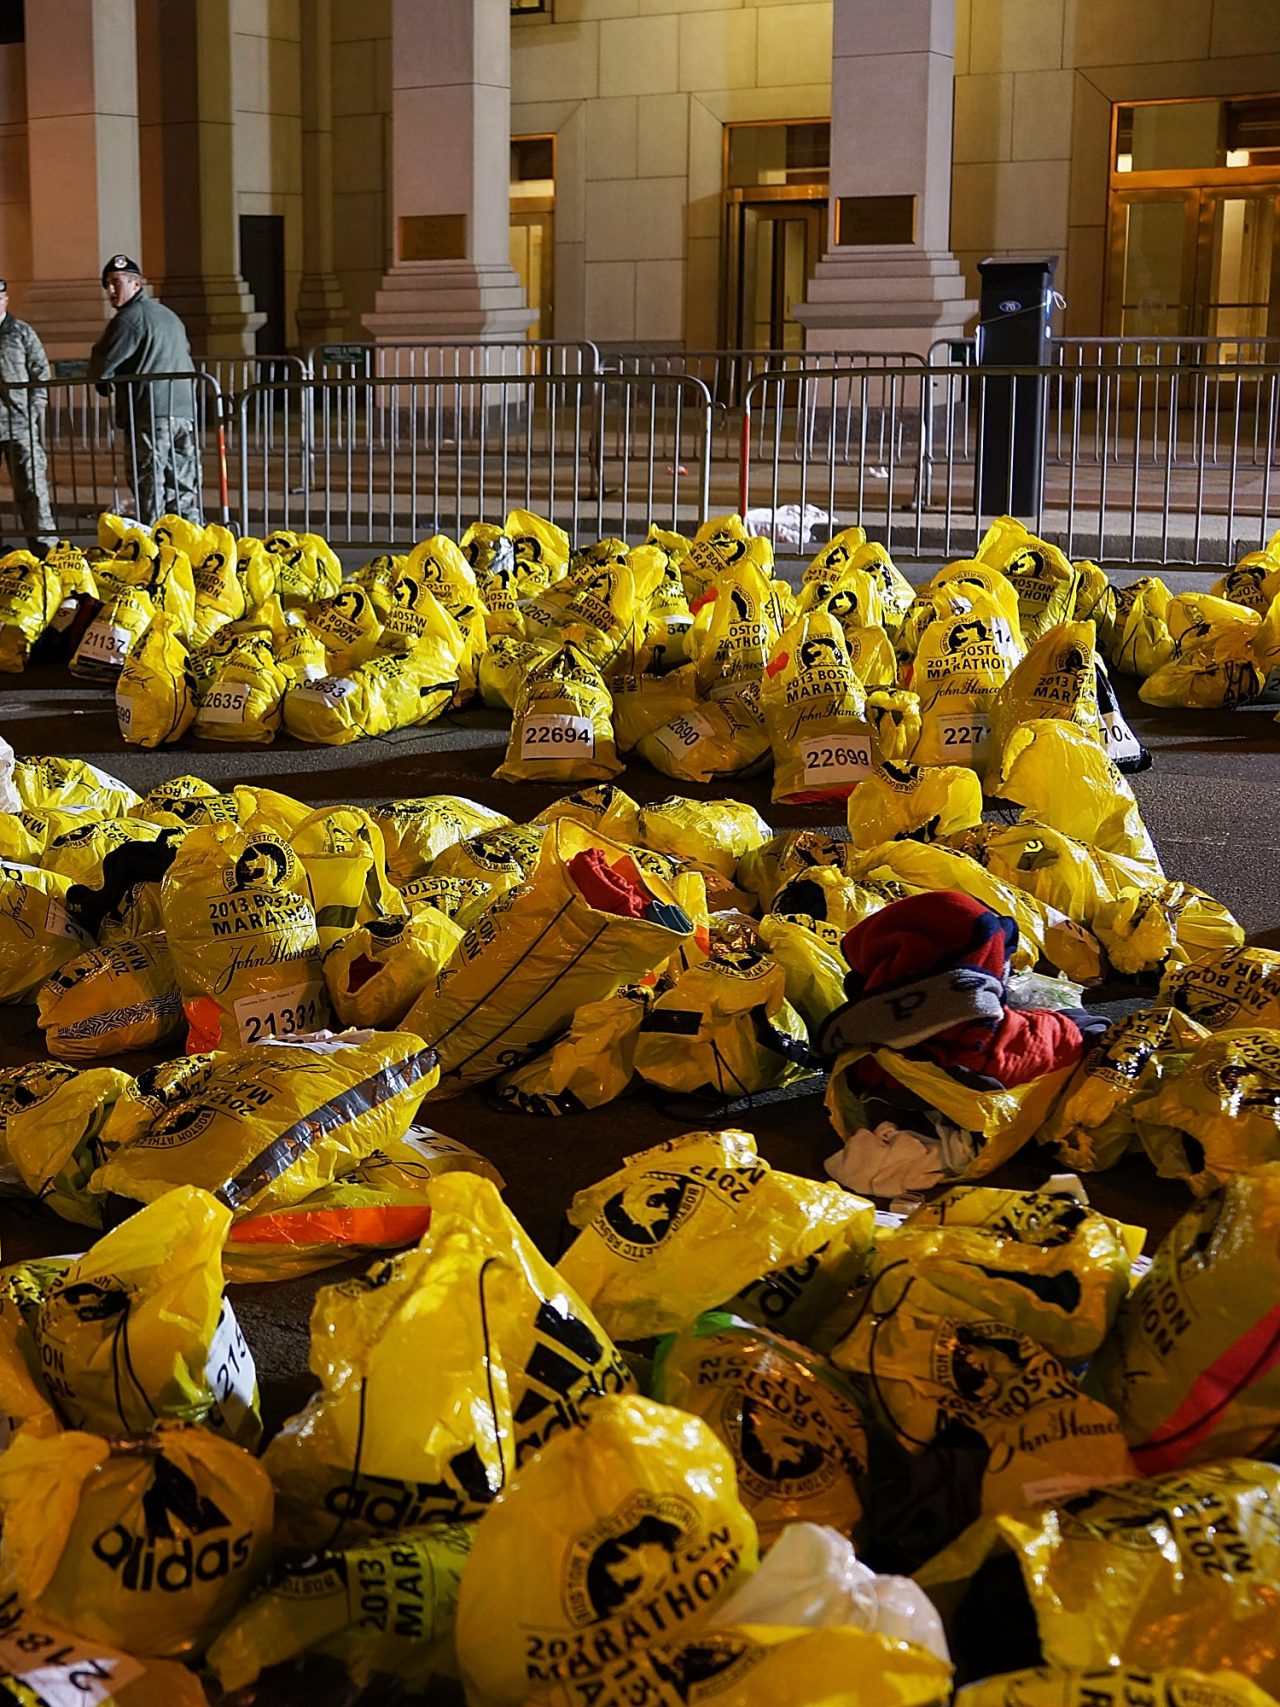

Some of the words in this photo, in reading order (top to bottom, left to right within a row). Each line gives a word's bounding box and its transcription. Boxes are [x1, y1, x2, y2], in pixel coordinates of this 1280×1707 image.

[1012, 578, 1056, 594] BOSTON
[1018, 588, 1052, 603] THON
[385, 618, 424, 639] RATHON
[729, 623, 763, 638] OSTO
[83, 631, 125, 652] 21137
[727, 635, 763, 650] ATHO
[927, 656, 958, 669] 2013
[786, 672, 814, 691] 2013
[817, 670, 850, 682] BOST
[1037, 675, 1069, 688] 2013
[786, 680, 851, 704] MARATH
[921, 686, 960, 712] John
[958, 676, 1000, 695] Hanco
[1033, 686, 1078, 704] MARA
[525, 727, 591, 744] 22694
[943, 726, 991, 746] 227
[807, 747, 869, 769] 22699
[208, 896, 250, 921] 2013
[213, 943, 266, 995] John
[357, 1557, 390, 1633] 2013
